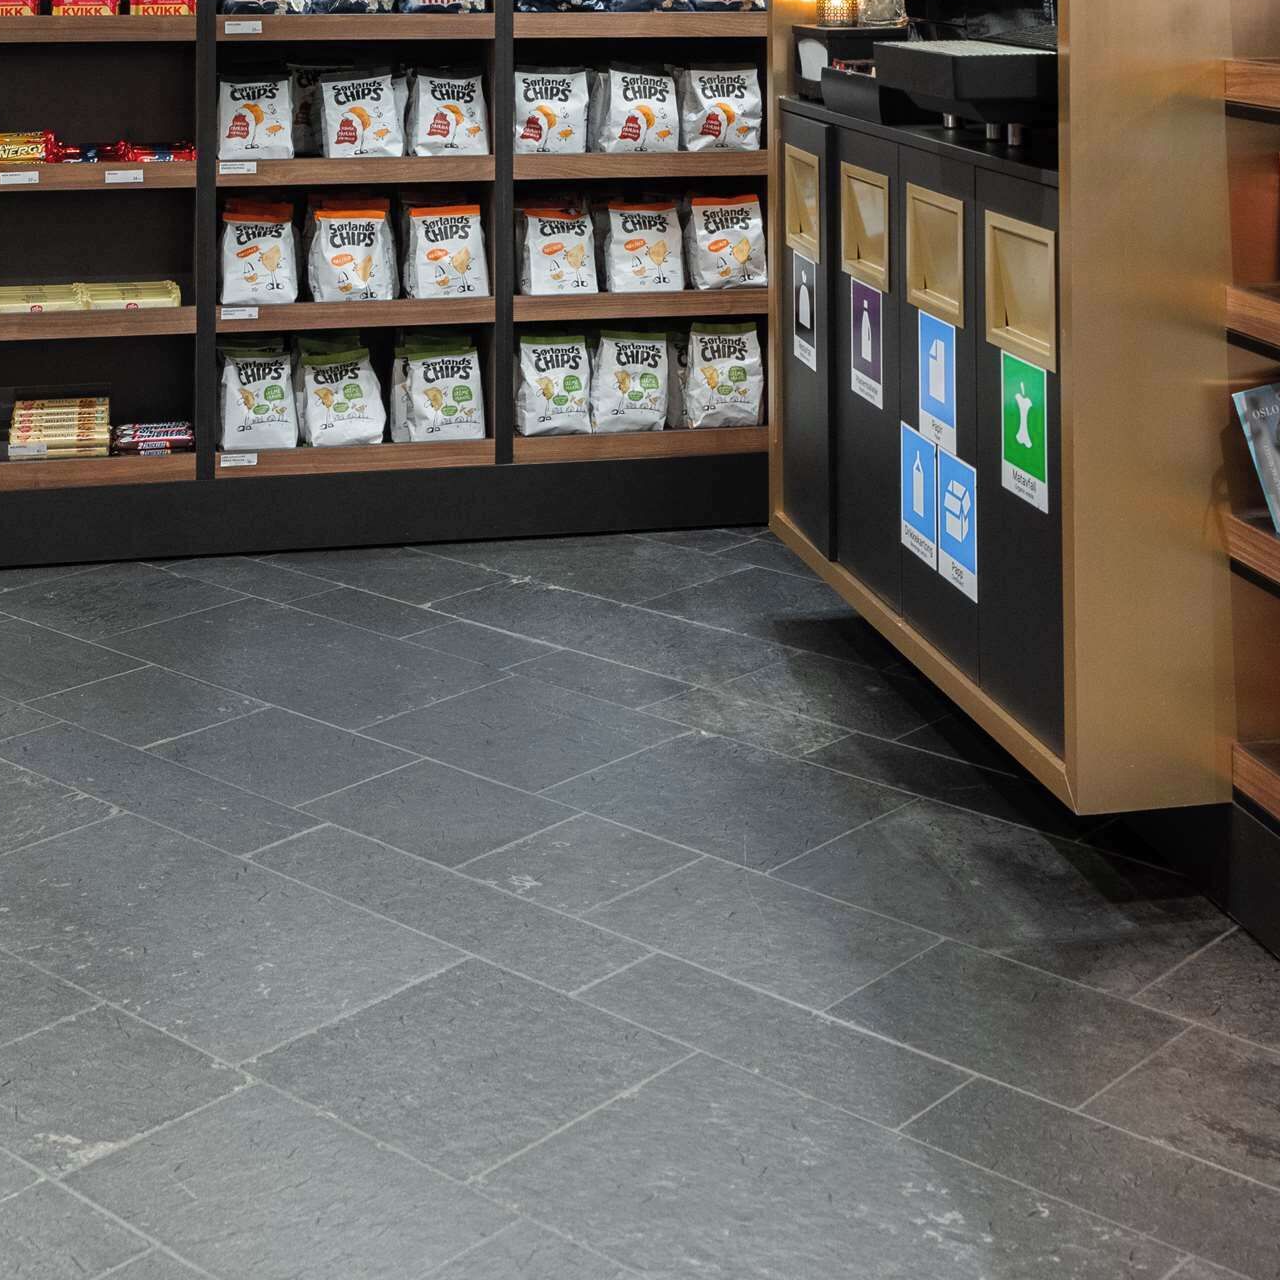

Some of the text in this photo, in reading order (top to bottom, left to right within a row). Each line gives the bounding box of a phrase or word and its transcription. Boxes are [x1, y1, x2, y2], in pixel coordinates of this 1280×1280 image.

[62, 7, 103, 16] KVIKK
[141, 6, 182, 16] KVIKK
[332, 80, 383, 92] Sørlands
[429, 80, 476, 91] Sørlands
[522, 77, 572, 88] Sørlands
[621, 75, 669, 89] Sørlands
[699, 75, 746, 86] Sørlands
[230, 87, 280, 102] CHIPS
[333, 87, 384, 106] CHIPS
[430, 89, 476, 103] CHIPS
[523, 87, 572, 102] CHIPS
[622, 86, 670, 103] CHIPS
[700, 84, 747, 99] CHIPS
[702, 207, 750, 221] Sørlands
[329, 221, 375, 234] Sørlands
[422, 216, 470, 230] Sørlands
[539, 222, 587, 237] CHIPS
[621, 219, 669, 234] CHIPS
[704, 216, 752, 234] CHIPS
[236, 228, 283, 245] CHIPS
[329, 231, 375, 248] CHIPS
[424, 224, 471, 243] CHIPS
[614, 342, 661, 353] Sørlands
[699, 335, 746, 348] Sørlands
[532, 345, 581, 358] Sørlands
[615, 349, 662, 368] CHIPS
[700, 344, 748, 362] CHIPS
[422, 357, 472, 371] Sørlands
[534, 353, 582, 372] CHIPS
[238, 367, 286, 386] CHIPS
[313, 367, 361, 385] CHIPS
[423, 365, 473, 383] CHIPS
[1251, 404, 1280, 419] OSLO
